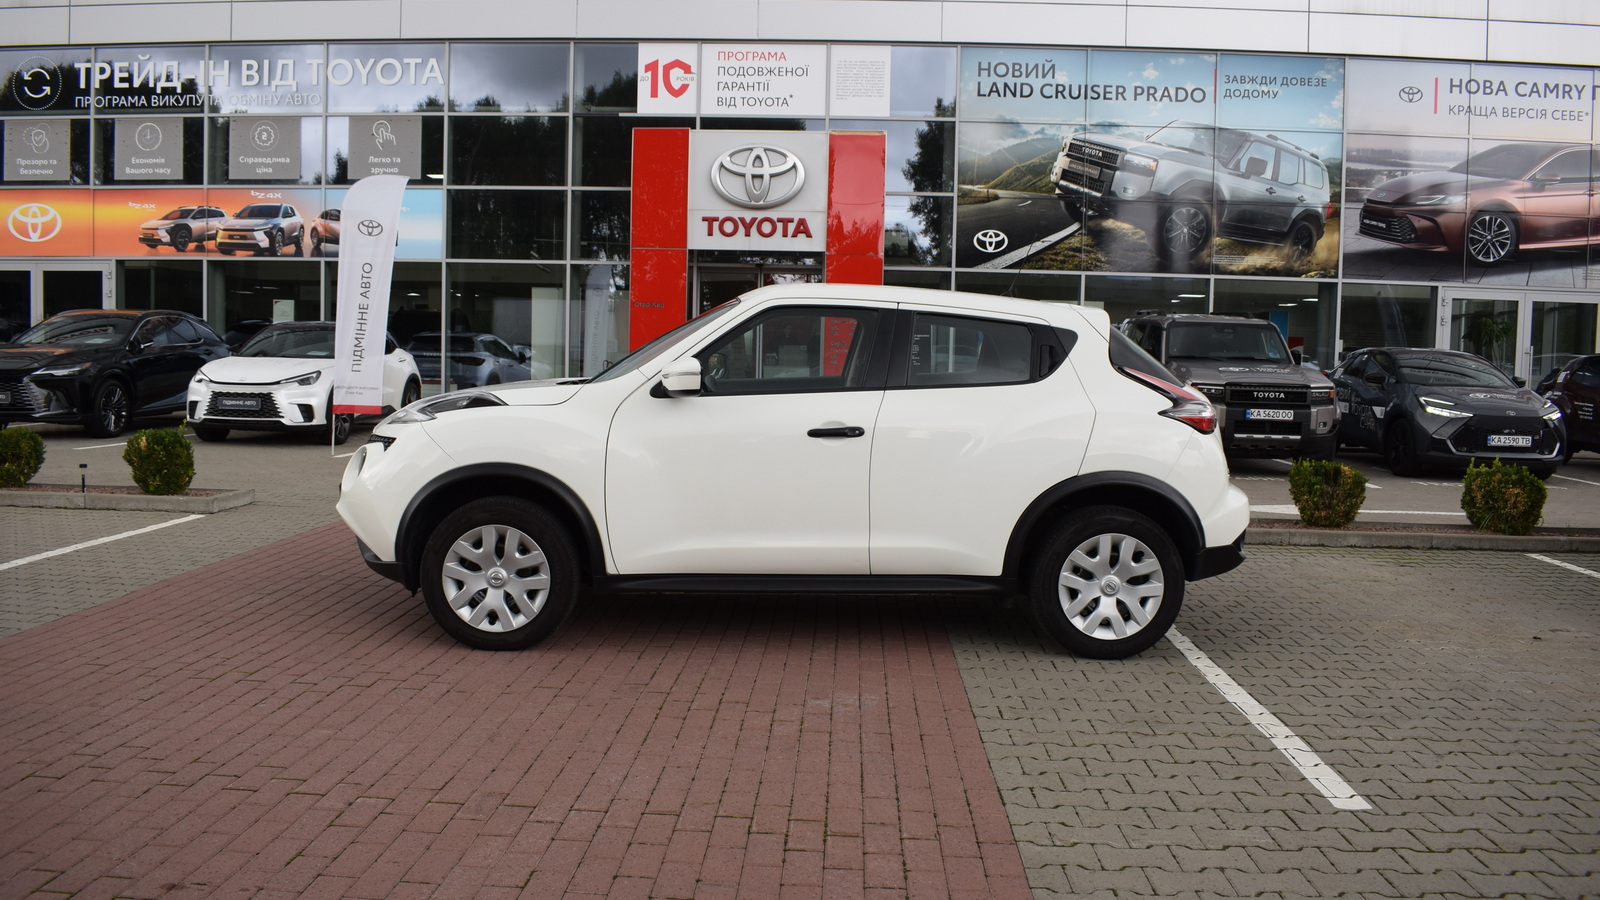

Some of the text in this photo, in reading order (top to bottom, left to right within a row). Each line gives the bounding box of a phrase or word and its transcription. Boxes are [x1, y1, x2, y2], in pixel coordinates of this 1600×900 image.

[718, 51, 786, 61] ПРОГРАМА
[242, 59, 298, 92] ВІД
[306, 58, 444, 86] TOYOTA
[718, 65, 809, 78] ПОДОВЖЕНОЇ
[977, 59, 1056, 79] НОВИЙ
[717, 80, 770, 91] ГАРАНТІЇ
[1224, 75, 1327, 87] ЗАВЖДИ ДОВЕЗЕ
[977, 82, 1206, 103] LAND CRUISER PRADO
[1224, 88, 1279, 100] ДОДОМУ
[1450, 78, 1508, 96] НОВА
[1514, 81, 1586, 100] CAMRY
[75, 94, 321, 108] ПРОГРАМА ВИКУПУ ТА ОБМІНУ АВТО
[717, 97, 737, 108] ВІД
[1449, 105, 1498, 118] КРАЩА
[1502, 107, 1547, 119] ВЕРСІЯ
[1082, 146, 1103, 157] TOYOTA
[702, 216, 813, 238] TOYOTA
[351, 263, 373, 372] ПІДМІННЕ АВТО
[1250, 410, 1262, 419] KA
[1263, 411, 1282, 419] 5620
[1351, 403, 1373, 417] TOYOTA
